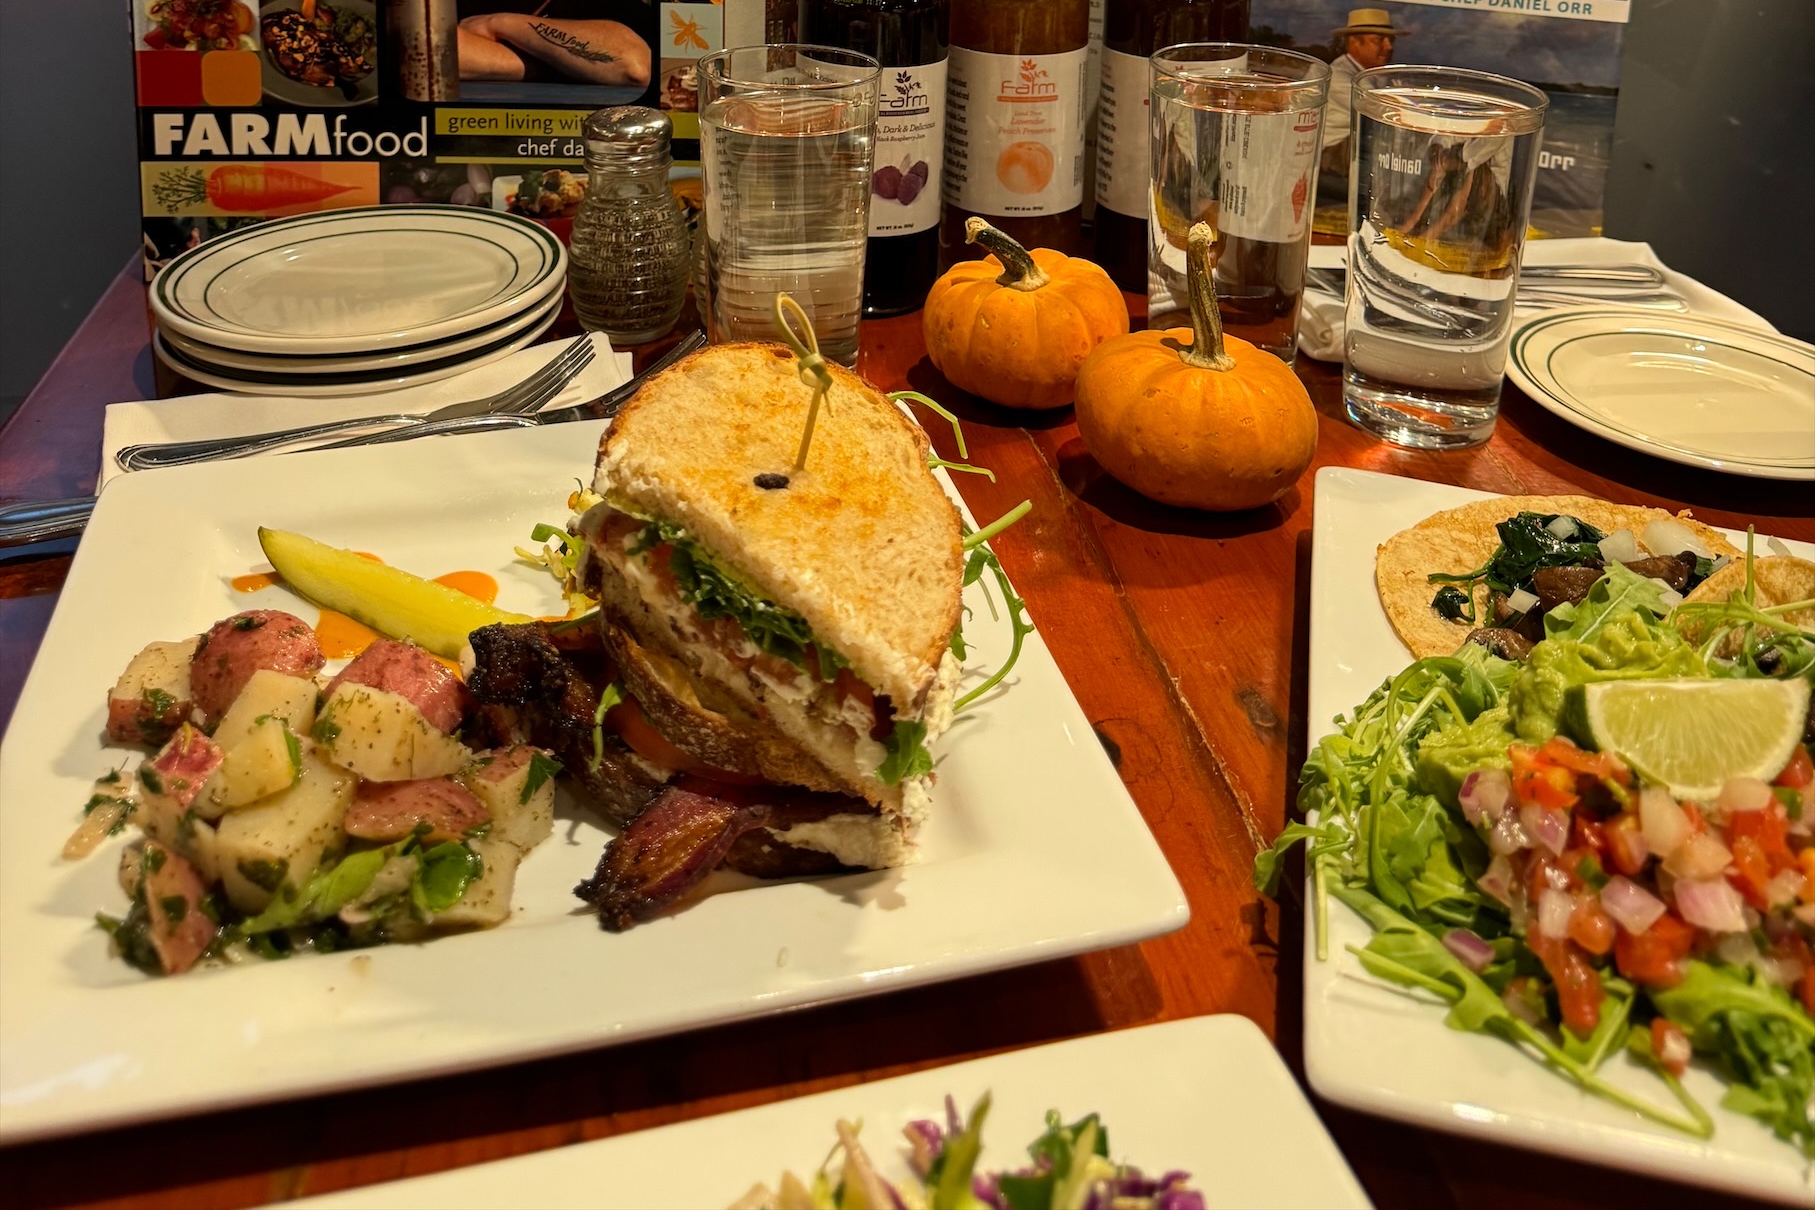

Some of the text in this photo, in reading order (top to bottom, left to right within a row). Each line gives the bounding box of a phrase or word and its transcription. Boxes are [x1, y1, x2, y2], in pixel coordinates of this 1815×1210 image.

[1557, 1, 1593, 15] ORR
[448, 112, 587, 134] green living wit
[517, 138, 558, 156] chef
[1538, 151, 1575, 172] Orr
